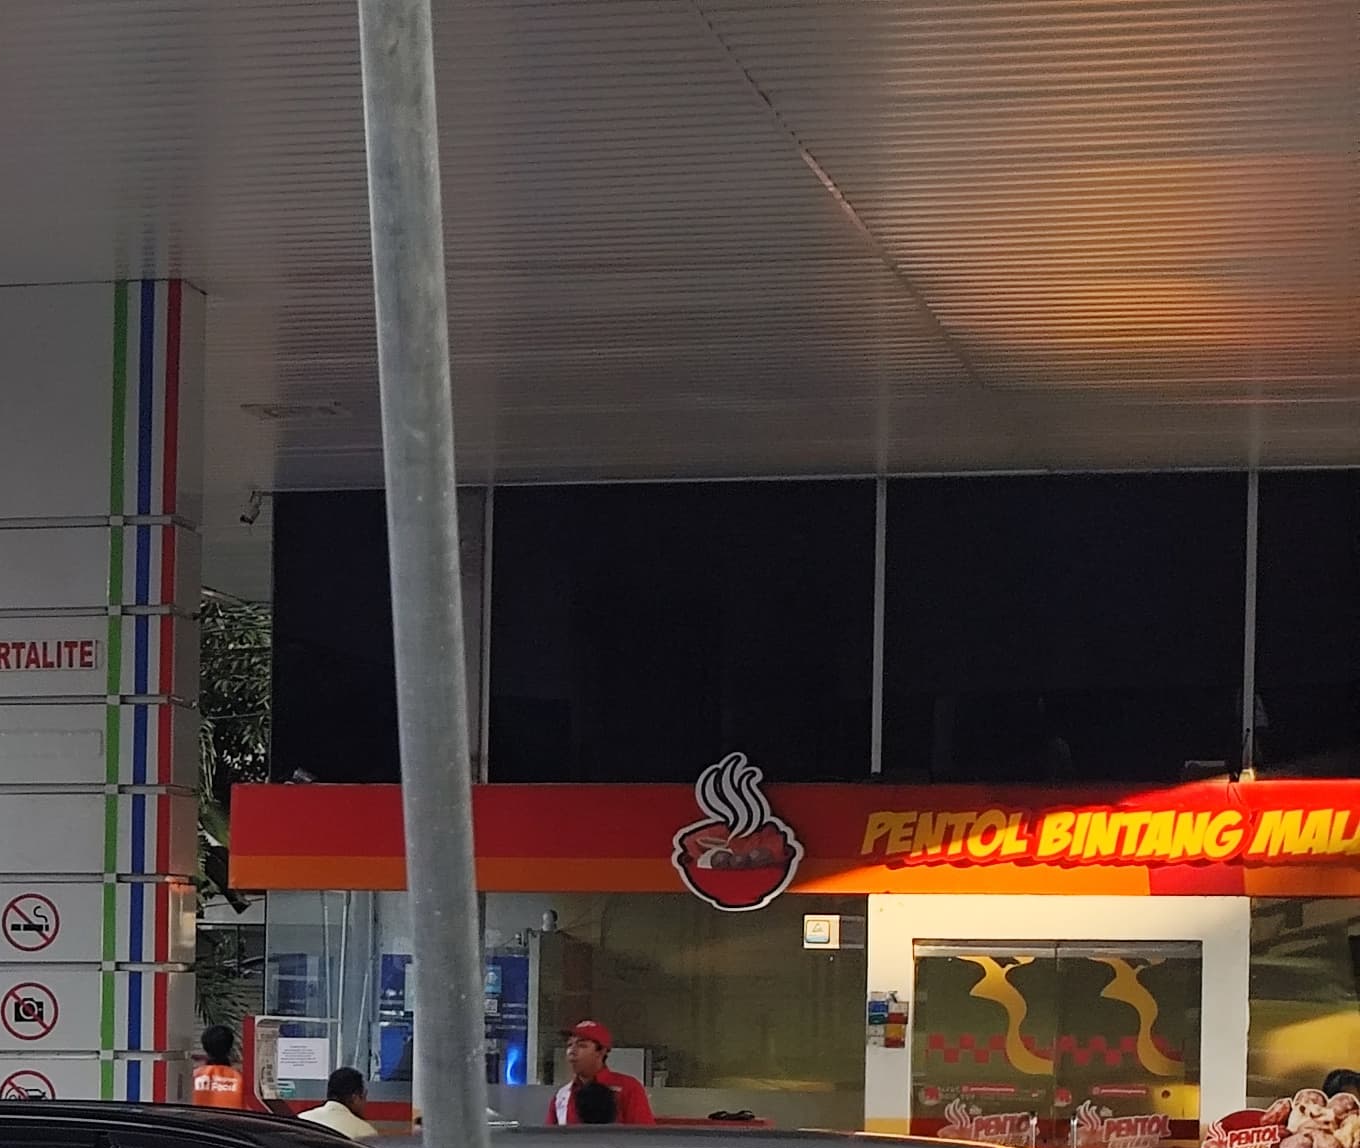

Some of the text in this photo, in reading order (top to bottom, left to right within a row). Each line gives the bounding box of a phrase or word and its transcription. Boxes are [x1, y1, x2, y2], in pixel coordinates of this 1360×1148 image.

[861, 808, 1032, 857] PENTOL
[1037, 807, 1245, 859] BINTANG
[1229, 1125, 1279, 1148] PENTOL
